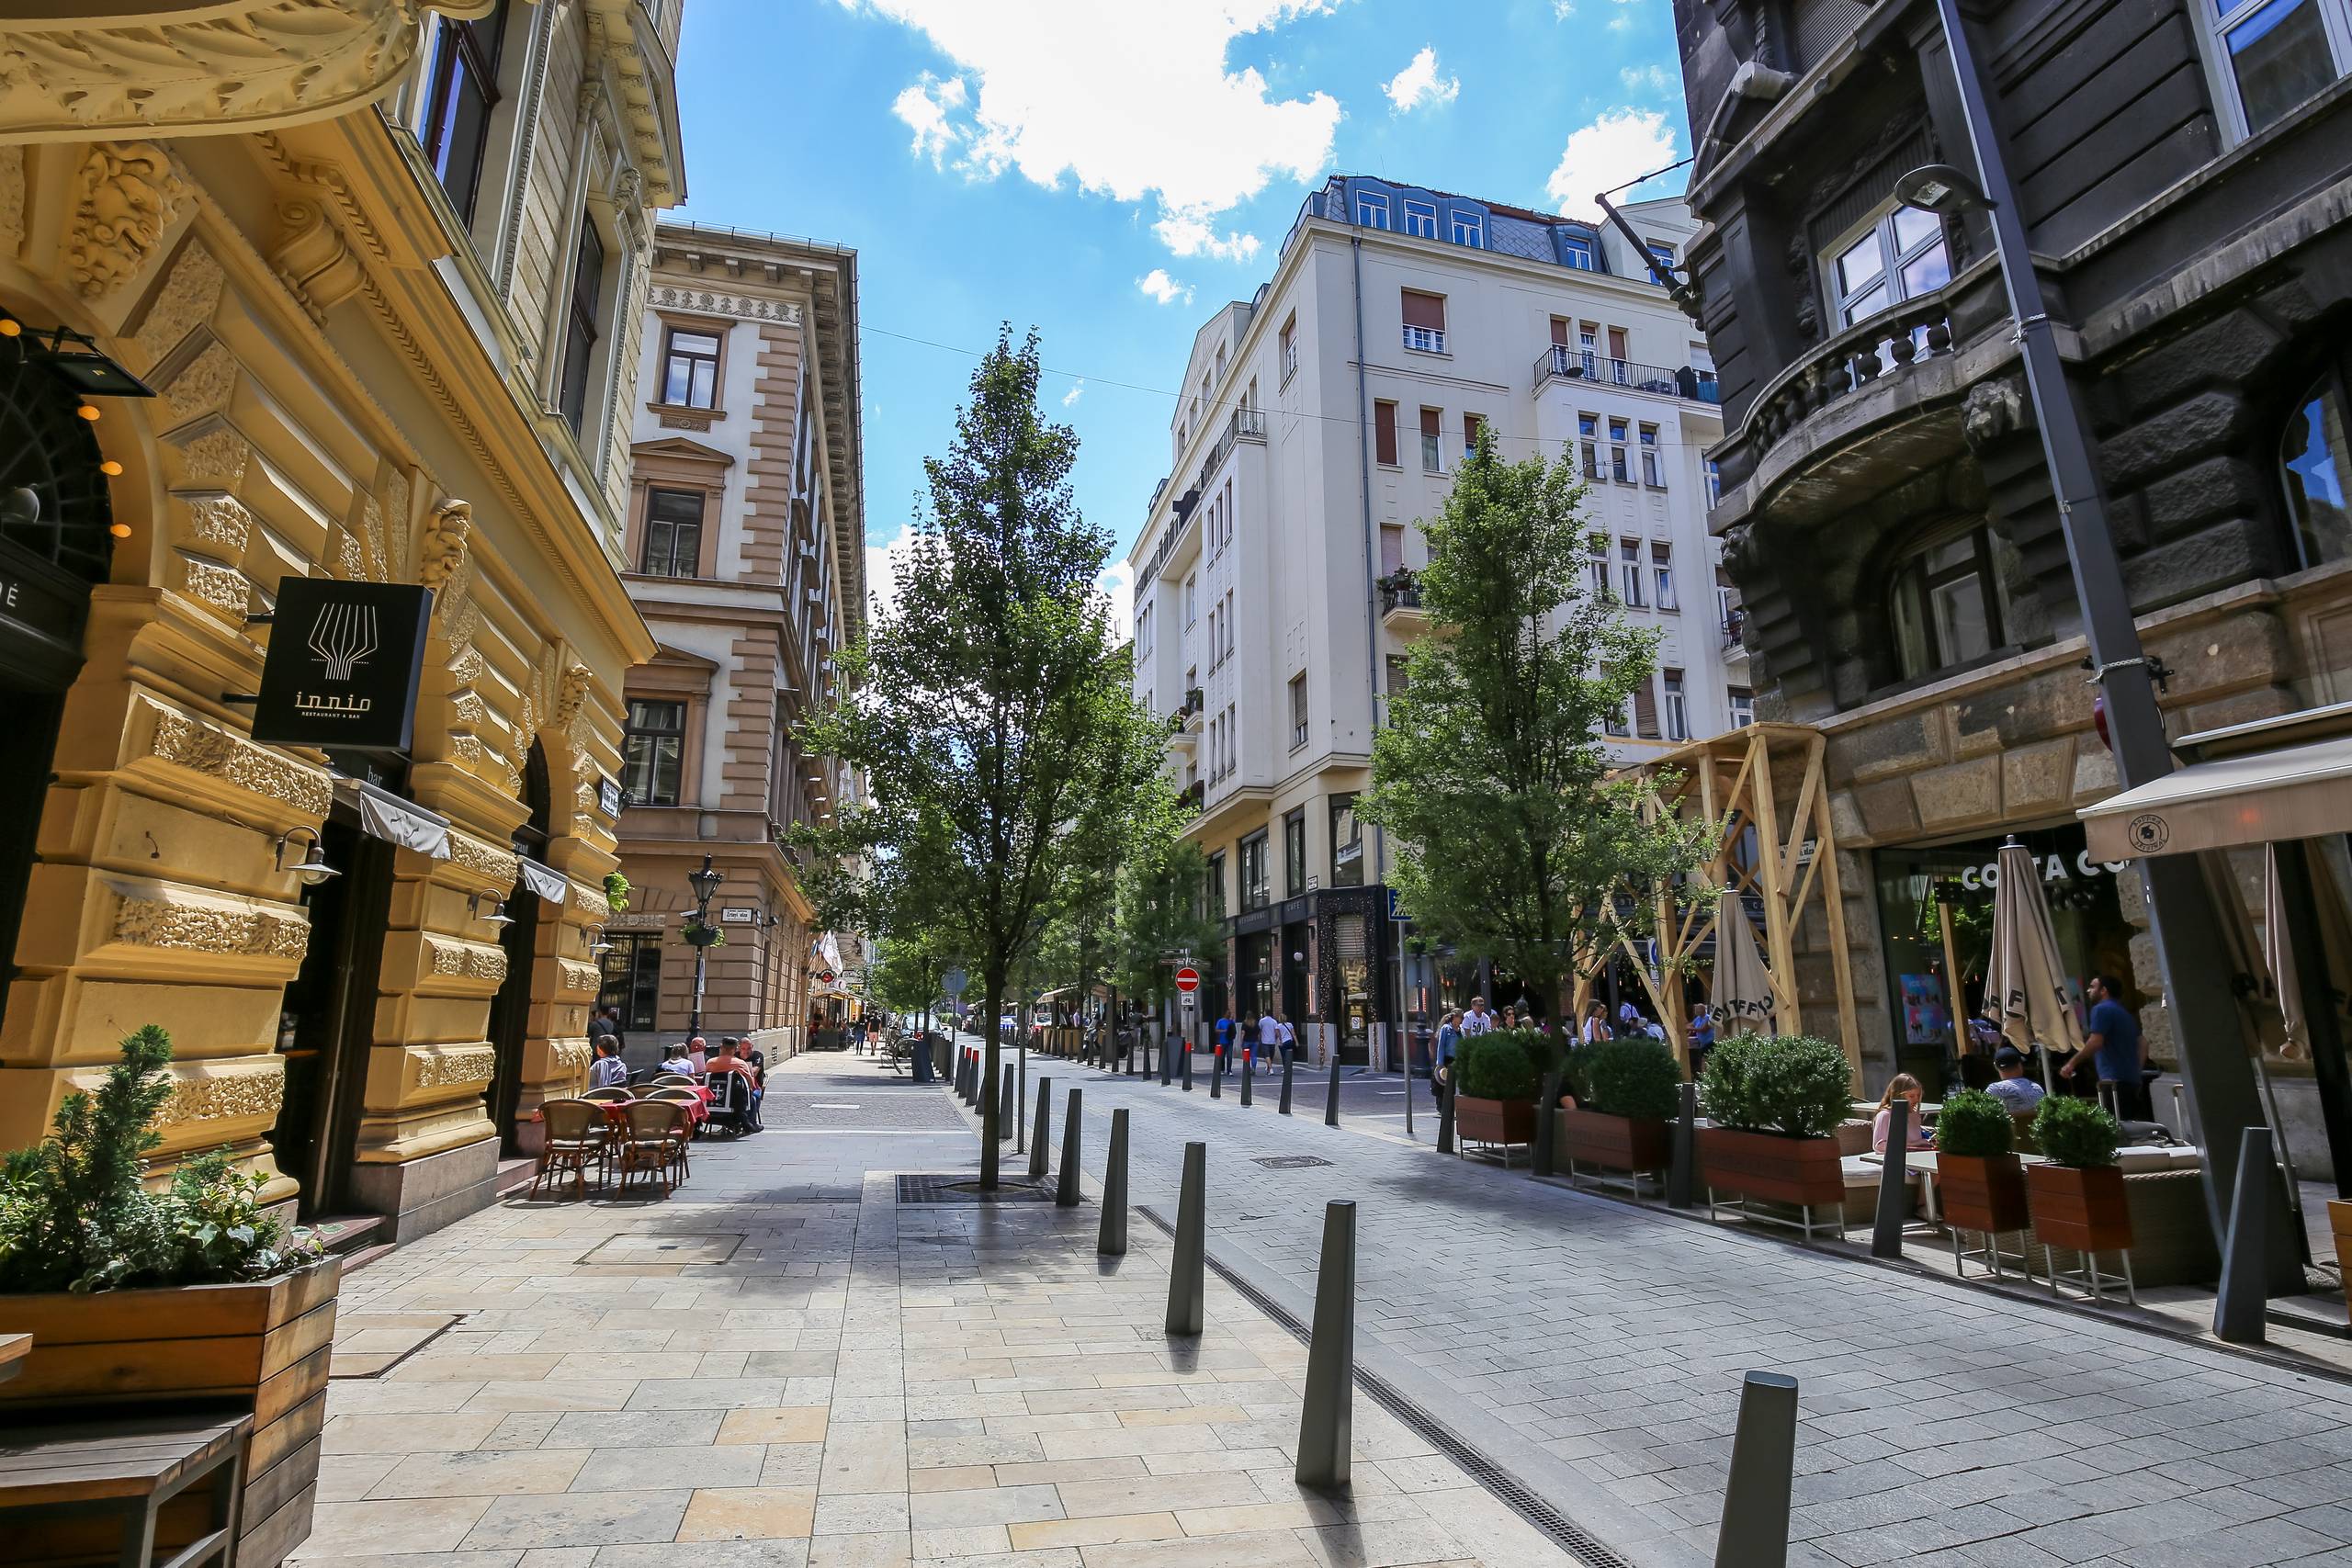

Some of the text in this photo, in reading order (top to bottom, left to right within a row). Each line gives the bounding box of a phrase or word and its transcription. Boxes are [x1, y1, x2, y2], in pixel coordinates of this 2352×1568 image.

[295, 692, 370, 711] innio
[368, 765, 383, 786] bar
[1473, 1021, 1485, 1032] 501
